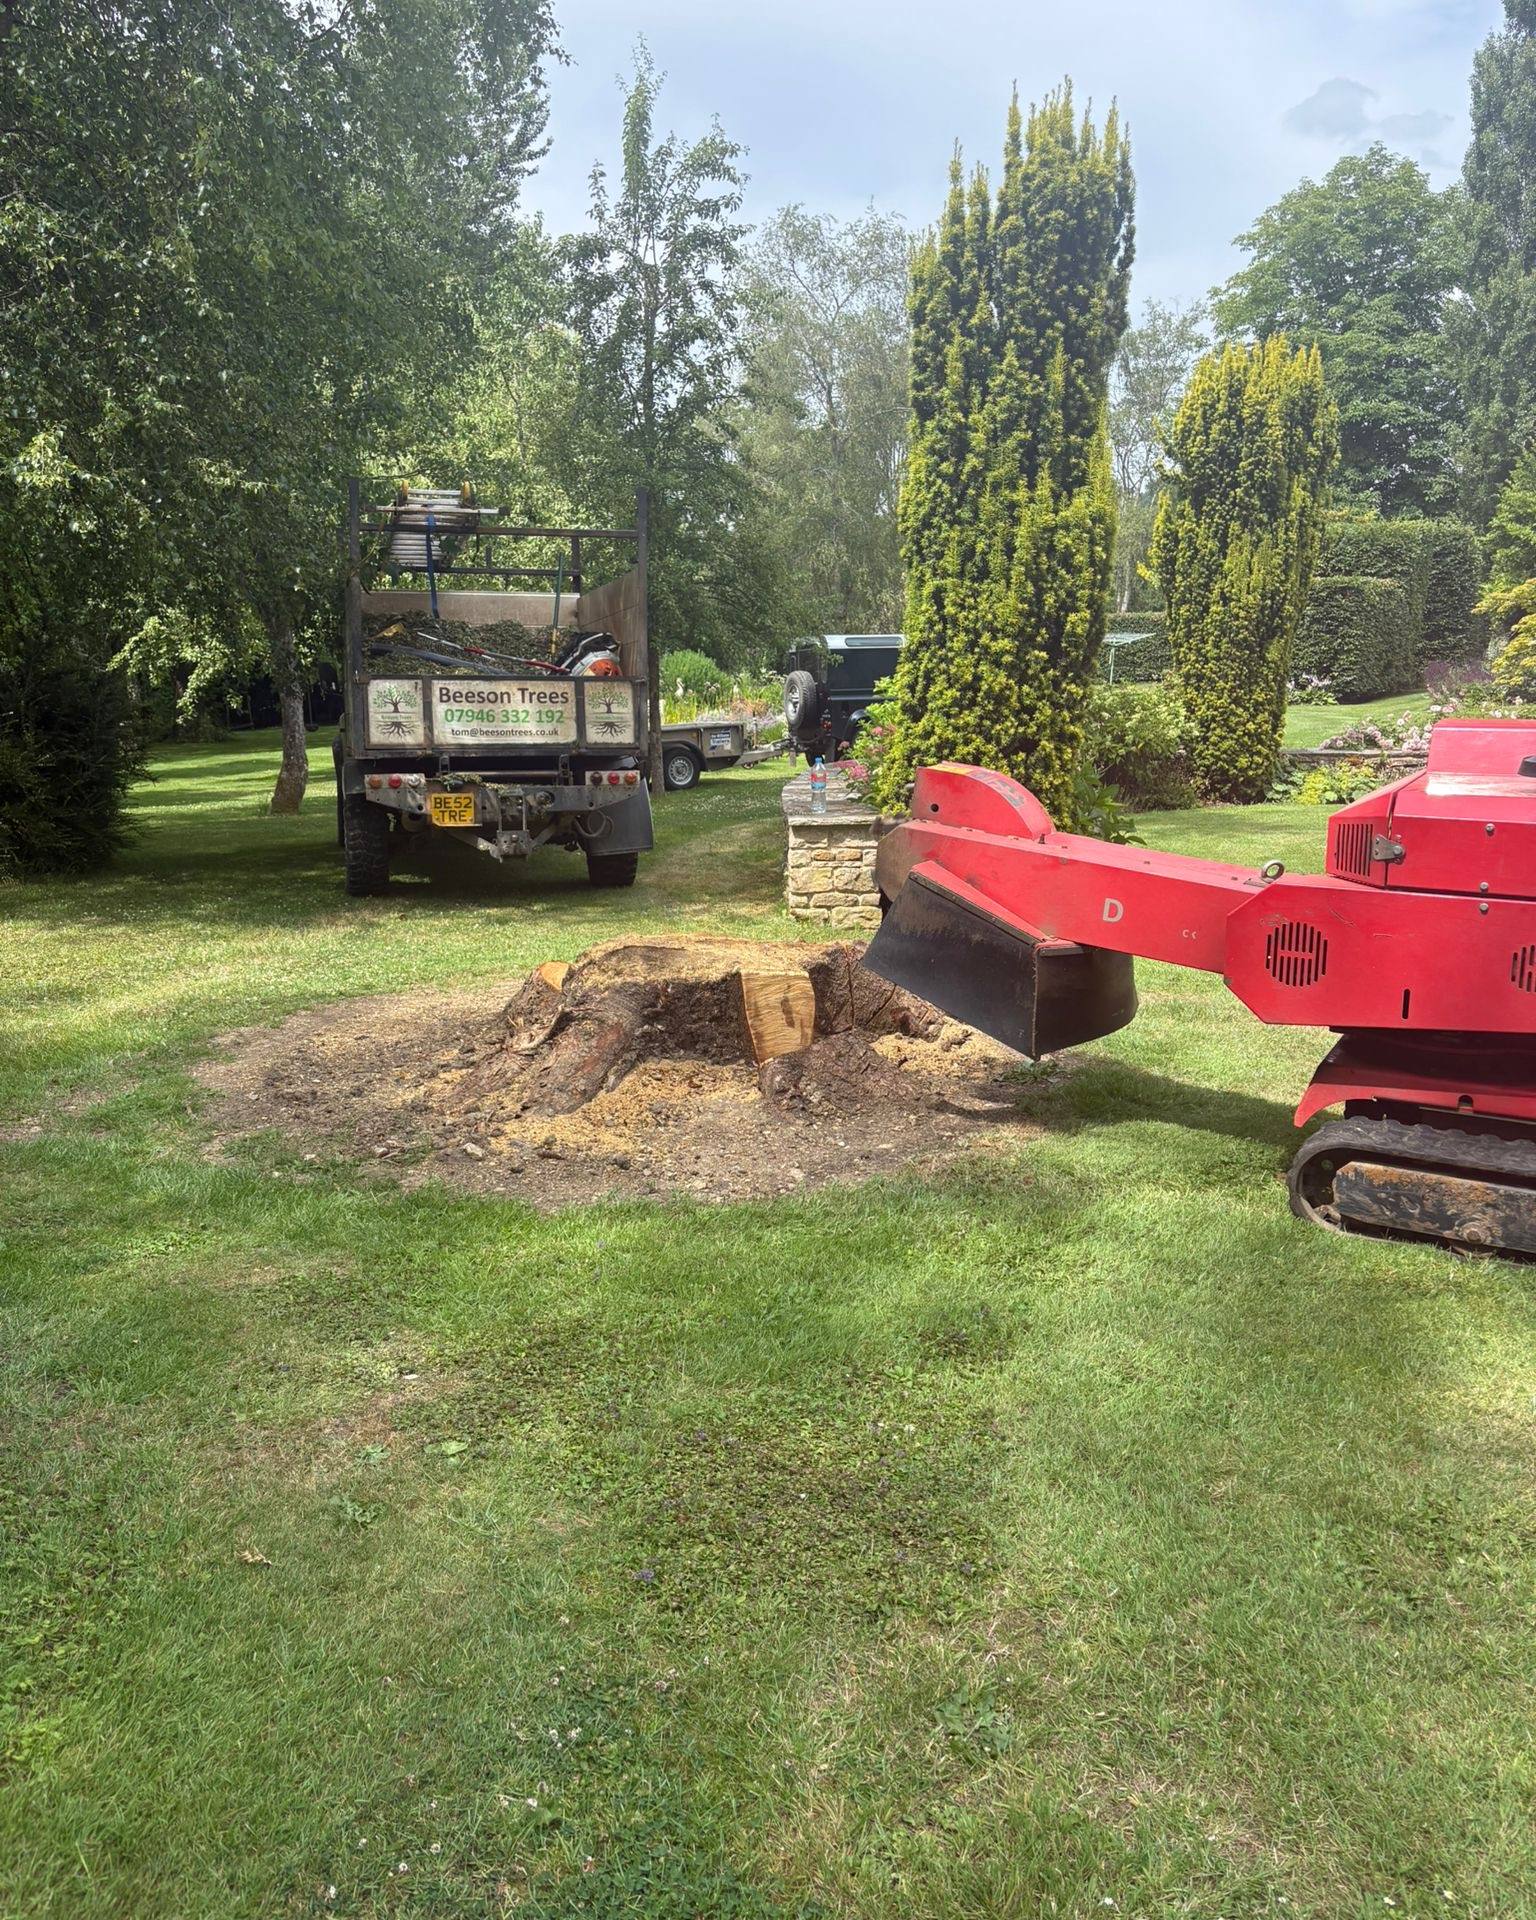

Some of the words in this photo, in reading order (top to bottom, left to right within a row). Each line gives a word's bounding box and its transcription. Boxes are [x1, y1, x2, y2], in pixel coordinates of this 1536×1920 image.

[439, 687, 512, 704] Beeson
[517, 688, 569, 704] Trees
[444, 708, 496, 723] 07946
[500, 709, 530, 723] 332
[535, 709, 564, 723] 192
[451, 728, 559, 737] tom@beesontrees.co.uk
[434, 797, 472, 809] BE52
[439, 810, 467, 822] TRE
[1102, 897, 1124, 923] D
